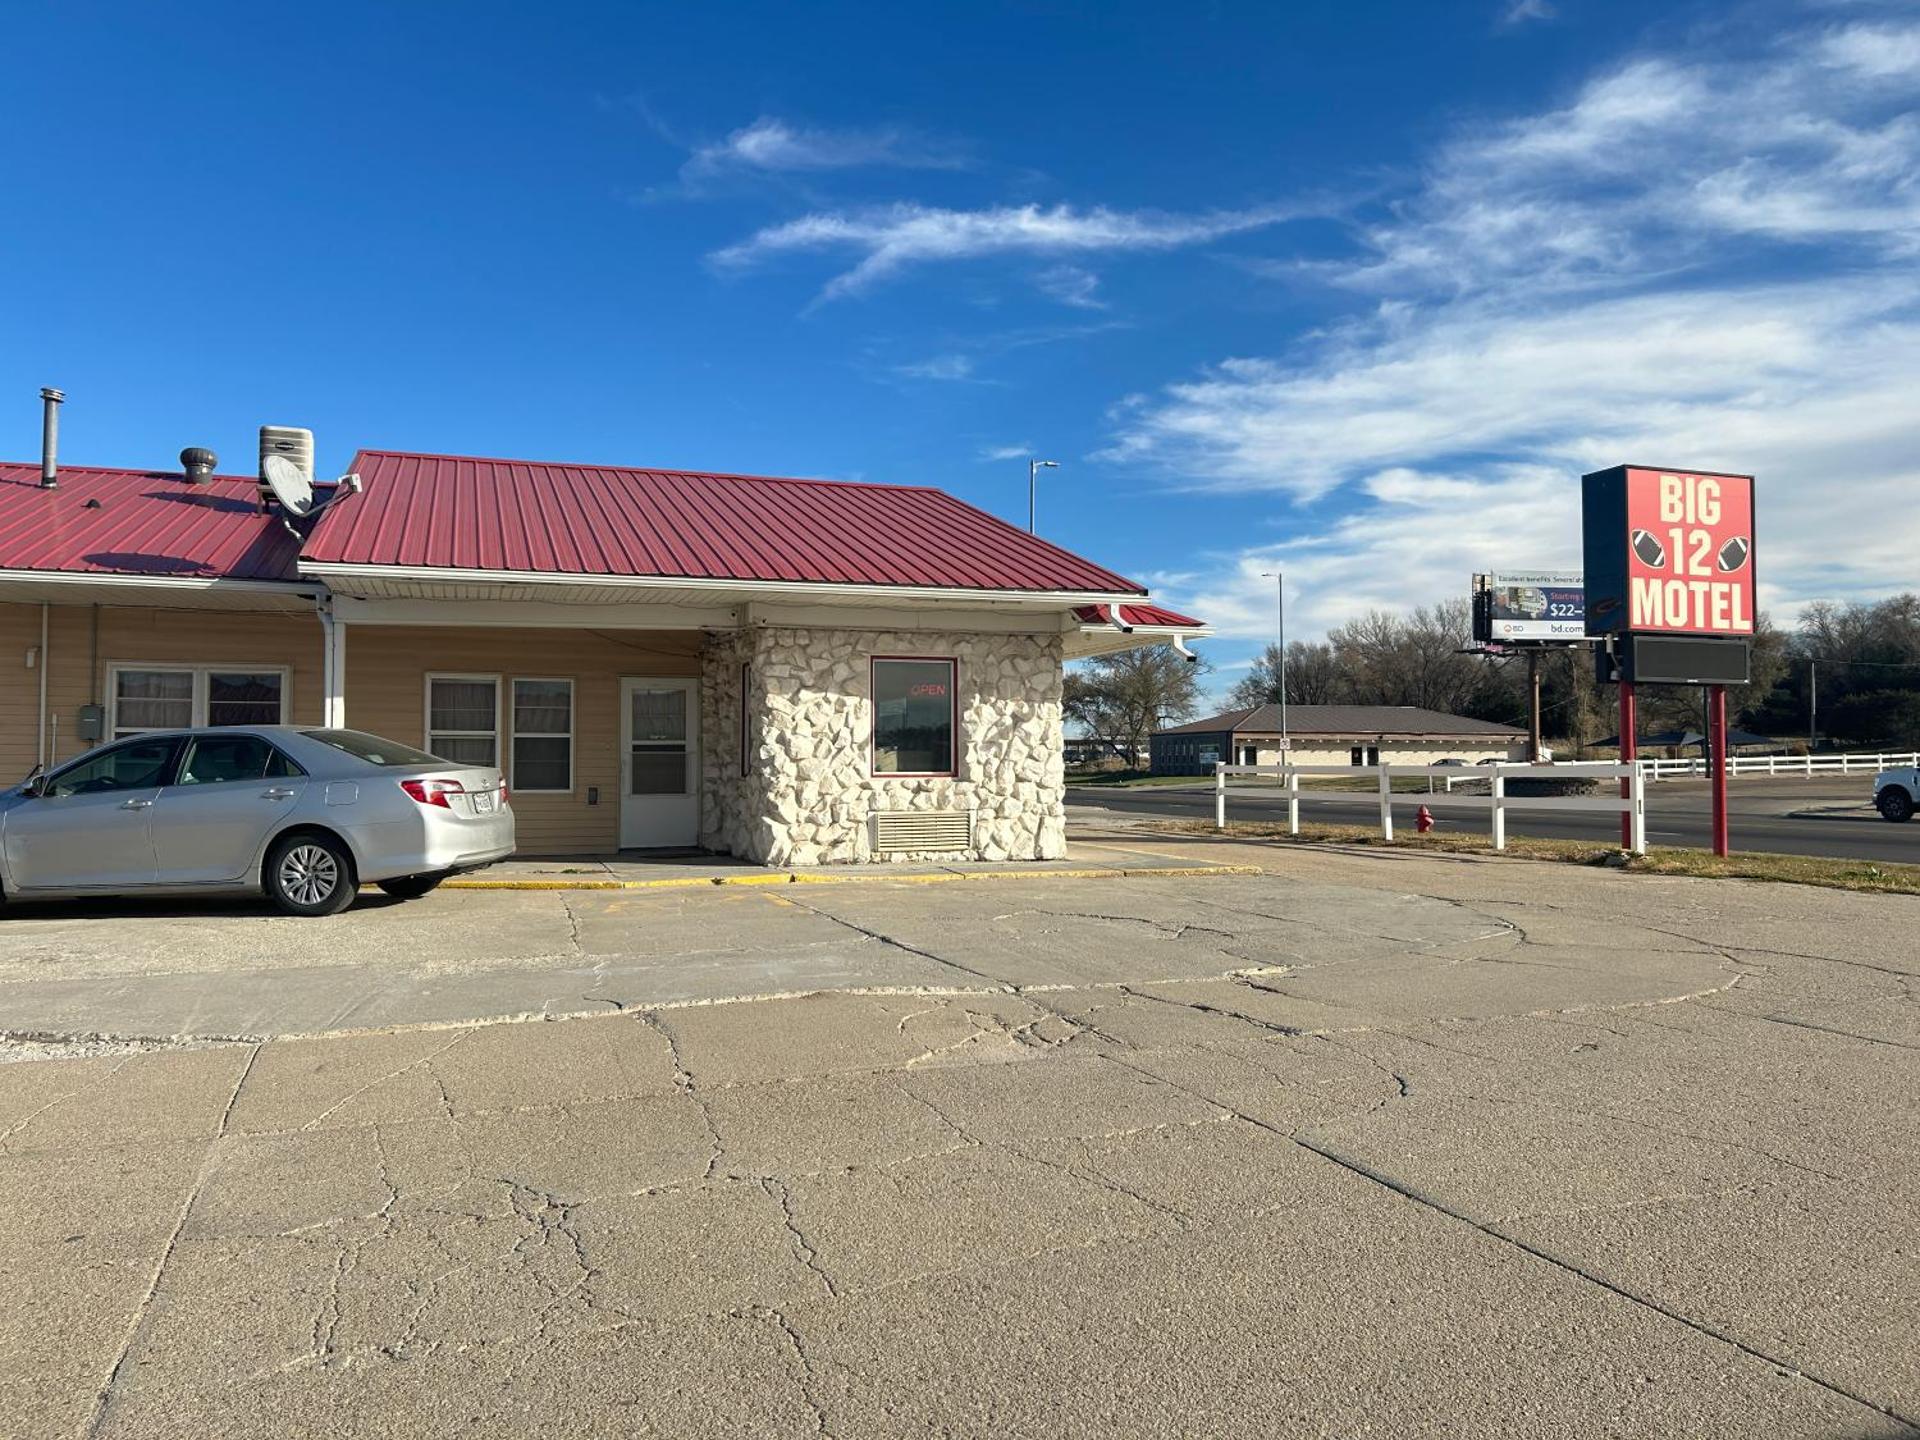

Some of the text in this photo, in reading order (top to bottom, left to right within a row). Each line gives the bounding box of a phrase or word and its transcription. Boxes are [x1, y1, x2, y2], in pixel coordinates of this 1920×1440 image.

[1659, 475, 1721, 526] BIG
[1668, 528, 1713, 577] 12
[1631, 577, 1751, 631] MOTEL
[911, 684, 946, 696] OPEN
